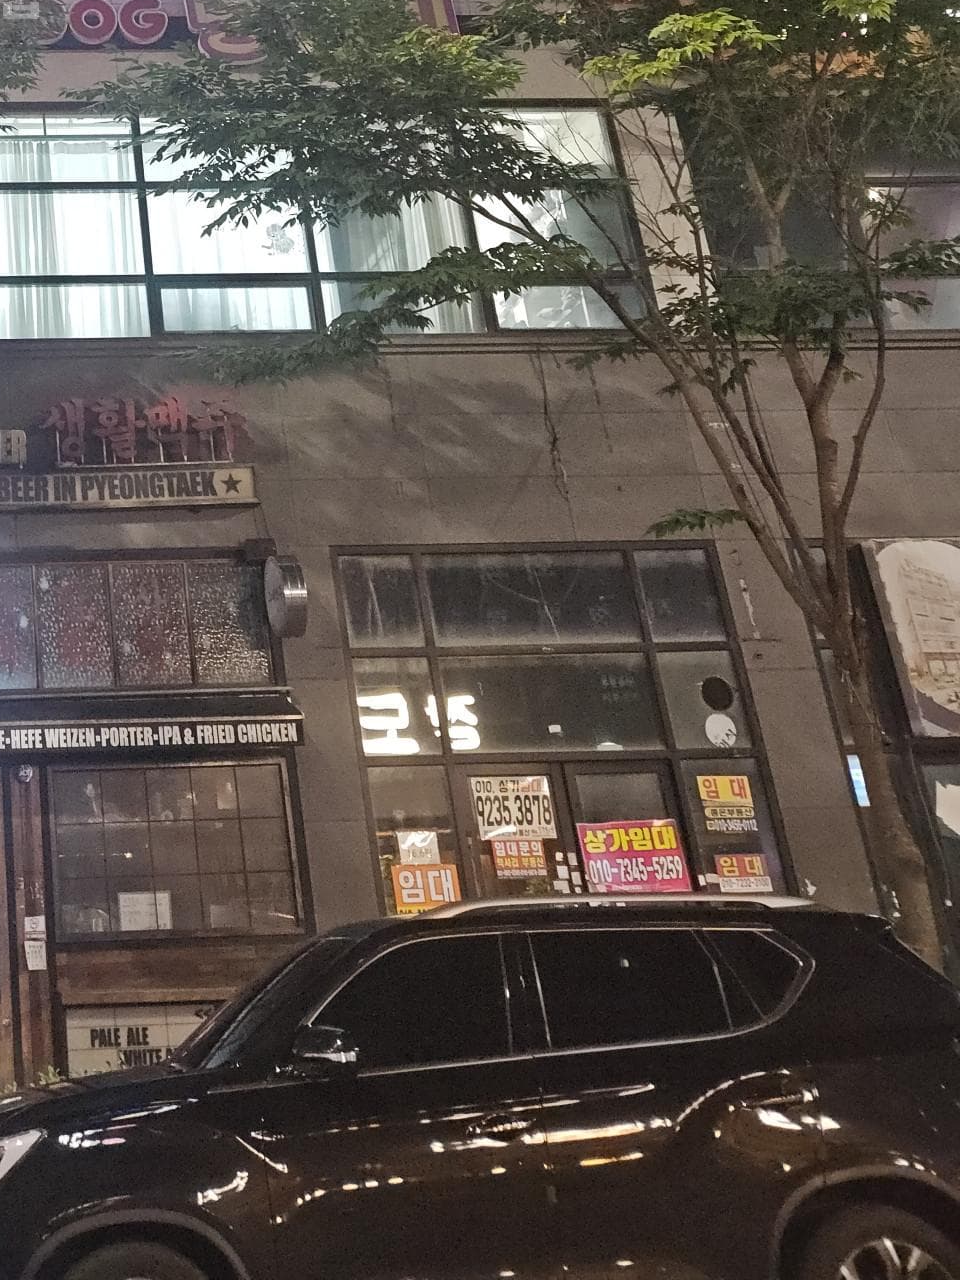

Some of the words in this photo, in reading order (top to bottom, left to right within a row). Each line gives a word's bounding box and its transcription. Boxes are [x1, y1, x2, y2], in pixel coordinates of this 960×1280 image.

[53, 474, 77, 502] IN
[81, 471, 217, 501] PYEONGTAEK
[183, 726, 194, 745] &
[196, 725, 235, 745] FRIED
[237, 723, 298, 743] CHICKEN
[476, 794, 552, 827] 9235.3878
[584, 826, 677, 854] 상가임대
[399, 869, 455, 904] 임대
[90, 1028, 121, 1048] PALE
[127, 1026, 149, 1046] ALE
